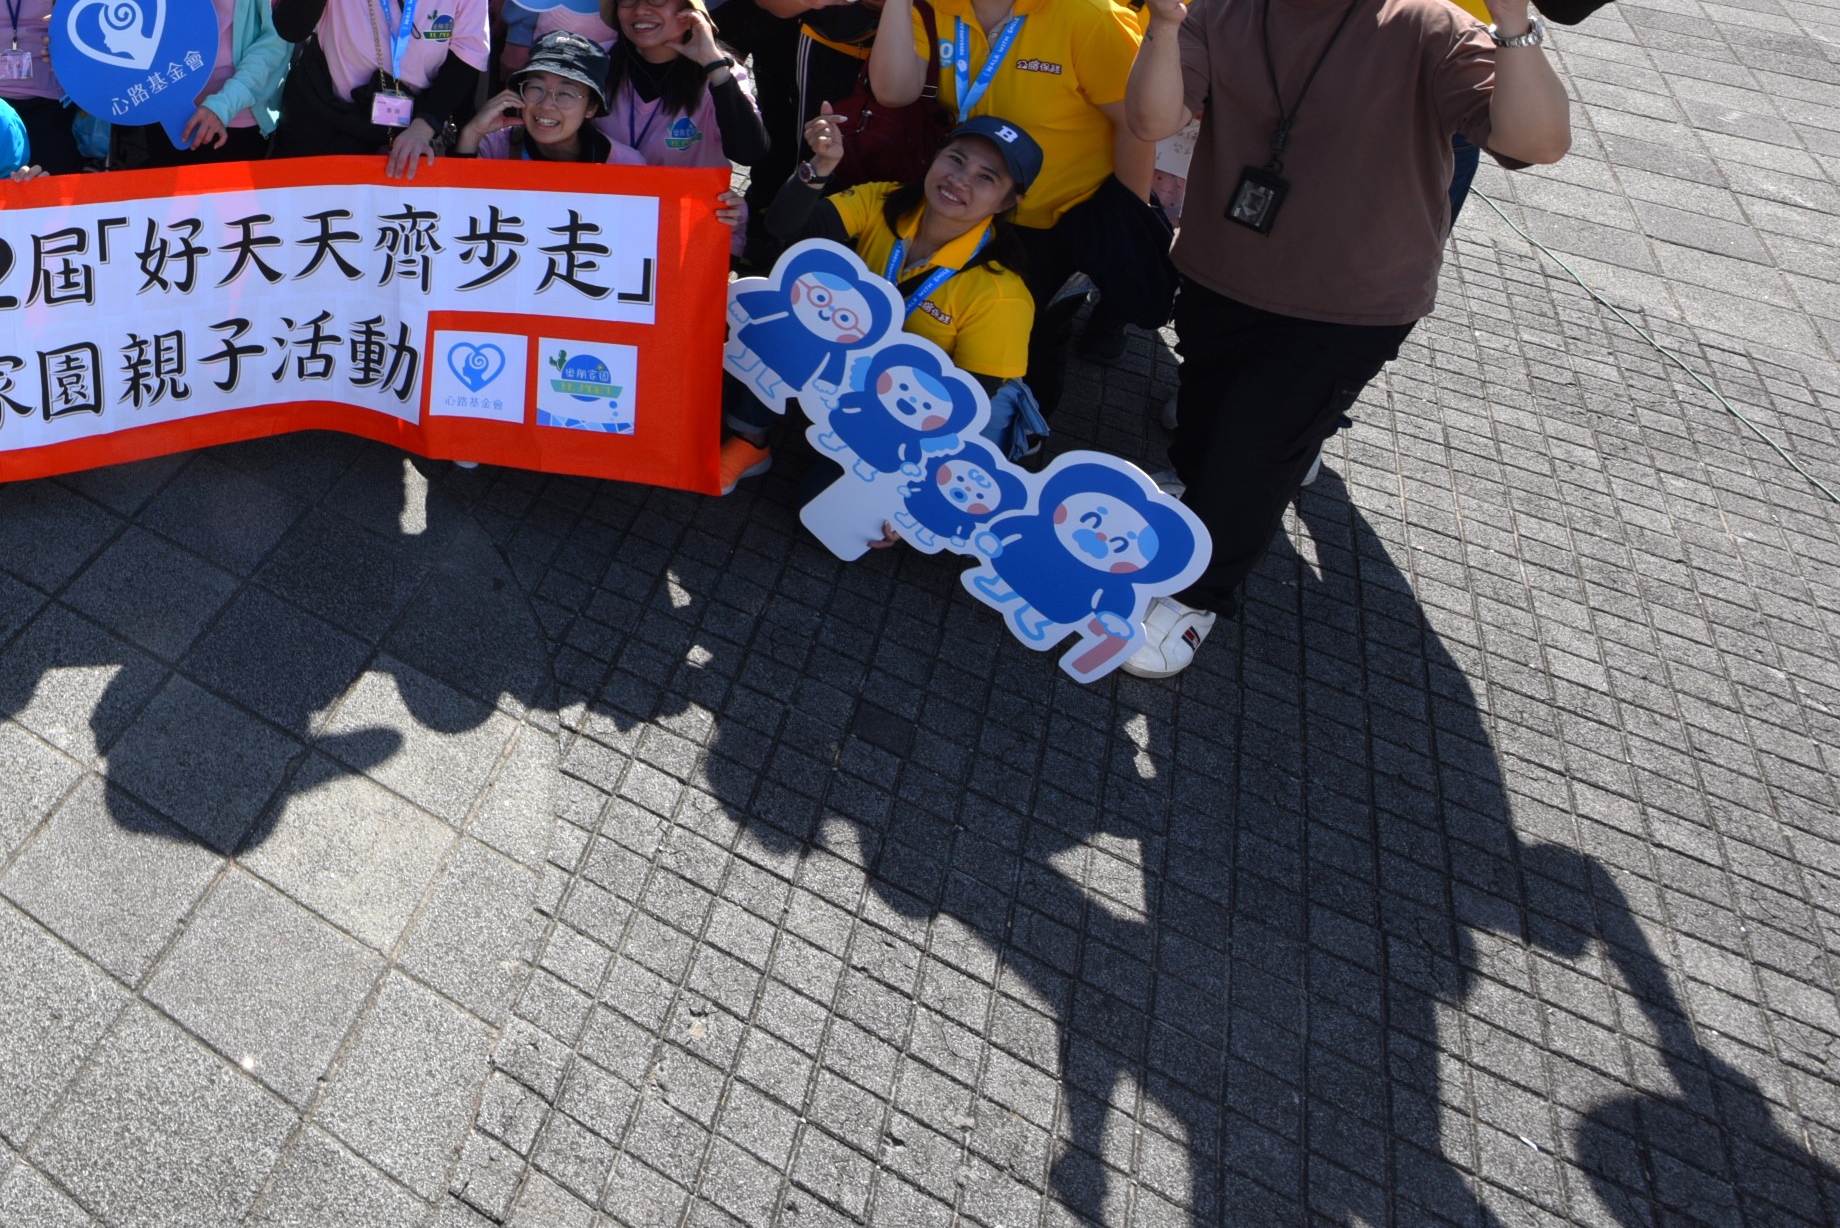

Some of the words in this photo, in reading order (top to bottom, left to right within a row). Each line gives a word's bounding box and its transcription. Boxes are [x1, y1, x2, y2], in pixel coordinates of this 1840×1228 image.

[1016, 58, 1062, 74] 公勝保經
[111, 50, 205, 116] 心路基金會
[994, 124, 1019, 143] B
[564, 367, 610, 382] 樂朋家園
[444, 395, 504, 412] 心路基金會
